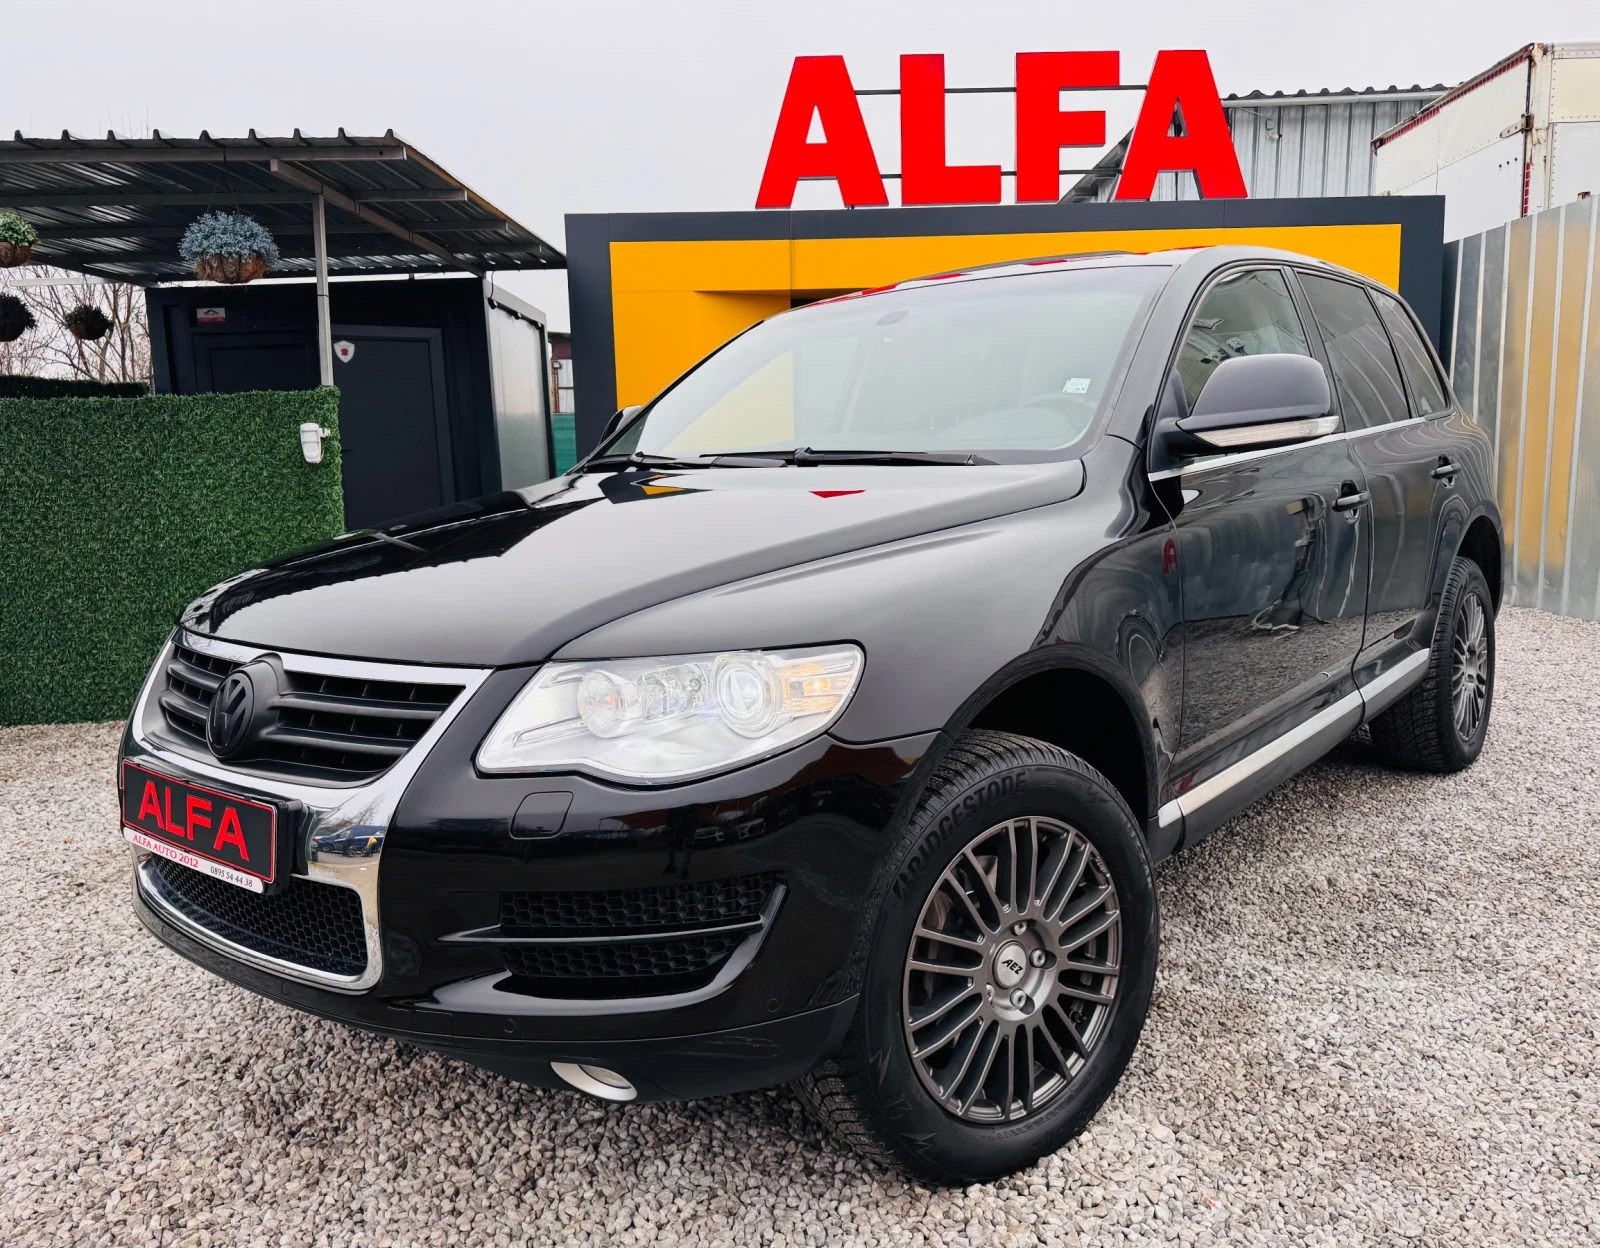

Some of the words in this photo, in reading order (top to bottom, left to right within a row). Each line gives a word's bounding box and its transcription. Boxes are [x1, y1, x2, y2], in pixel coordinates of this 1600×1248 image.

[755, 50, 1248, 209] ALFA
[138, 780, 249, 861] ALFA
[892, 771, 1026, 899] BRIDGESTONE
[133, 833, 151, 849] ALFA
[153, 842, 177, 858] AUTO
[179, 854, 199, 868] 2012
[210, 866, 225, 878] 0895
[225, 870, 234, 881] 54
[234, 873, 243, 885] 44
[244, 878, 253, 888] 38
[1001, 959, 1023, 975] AEZ
